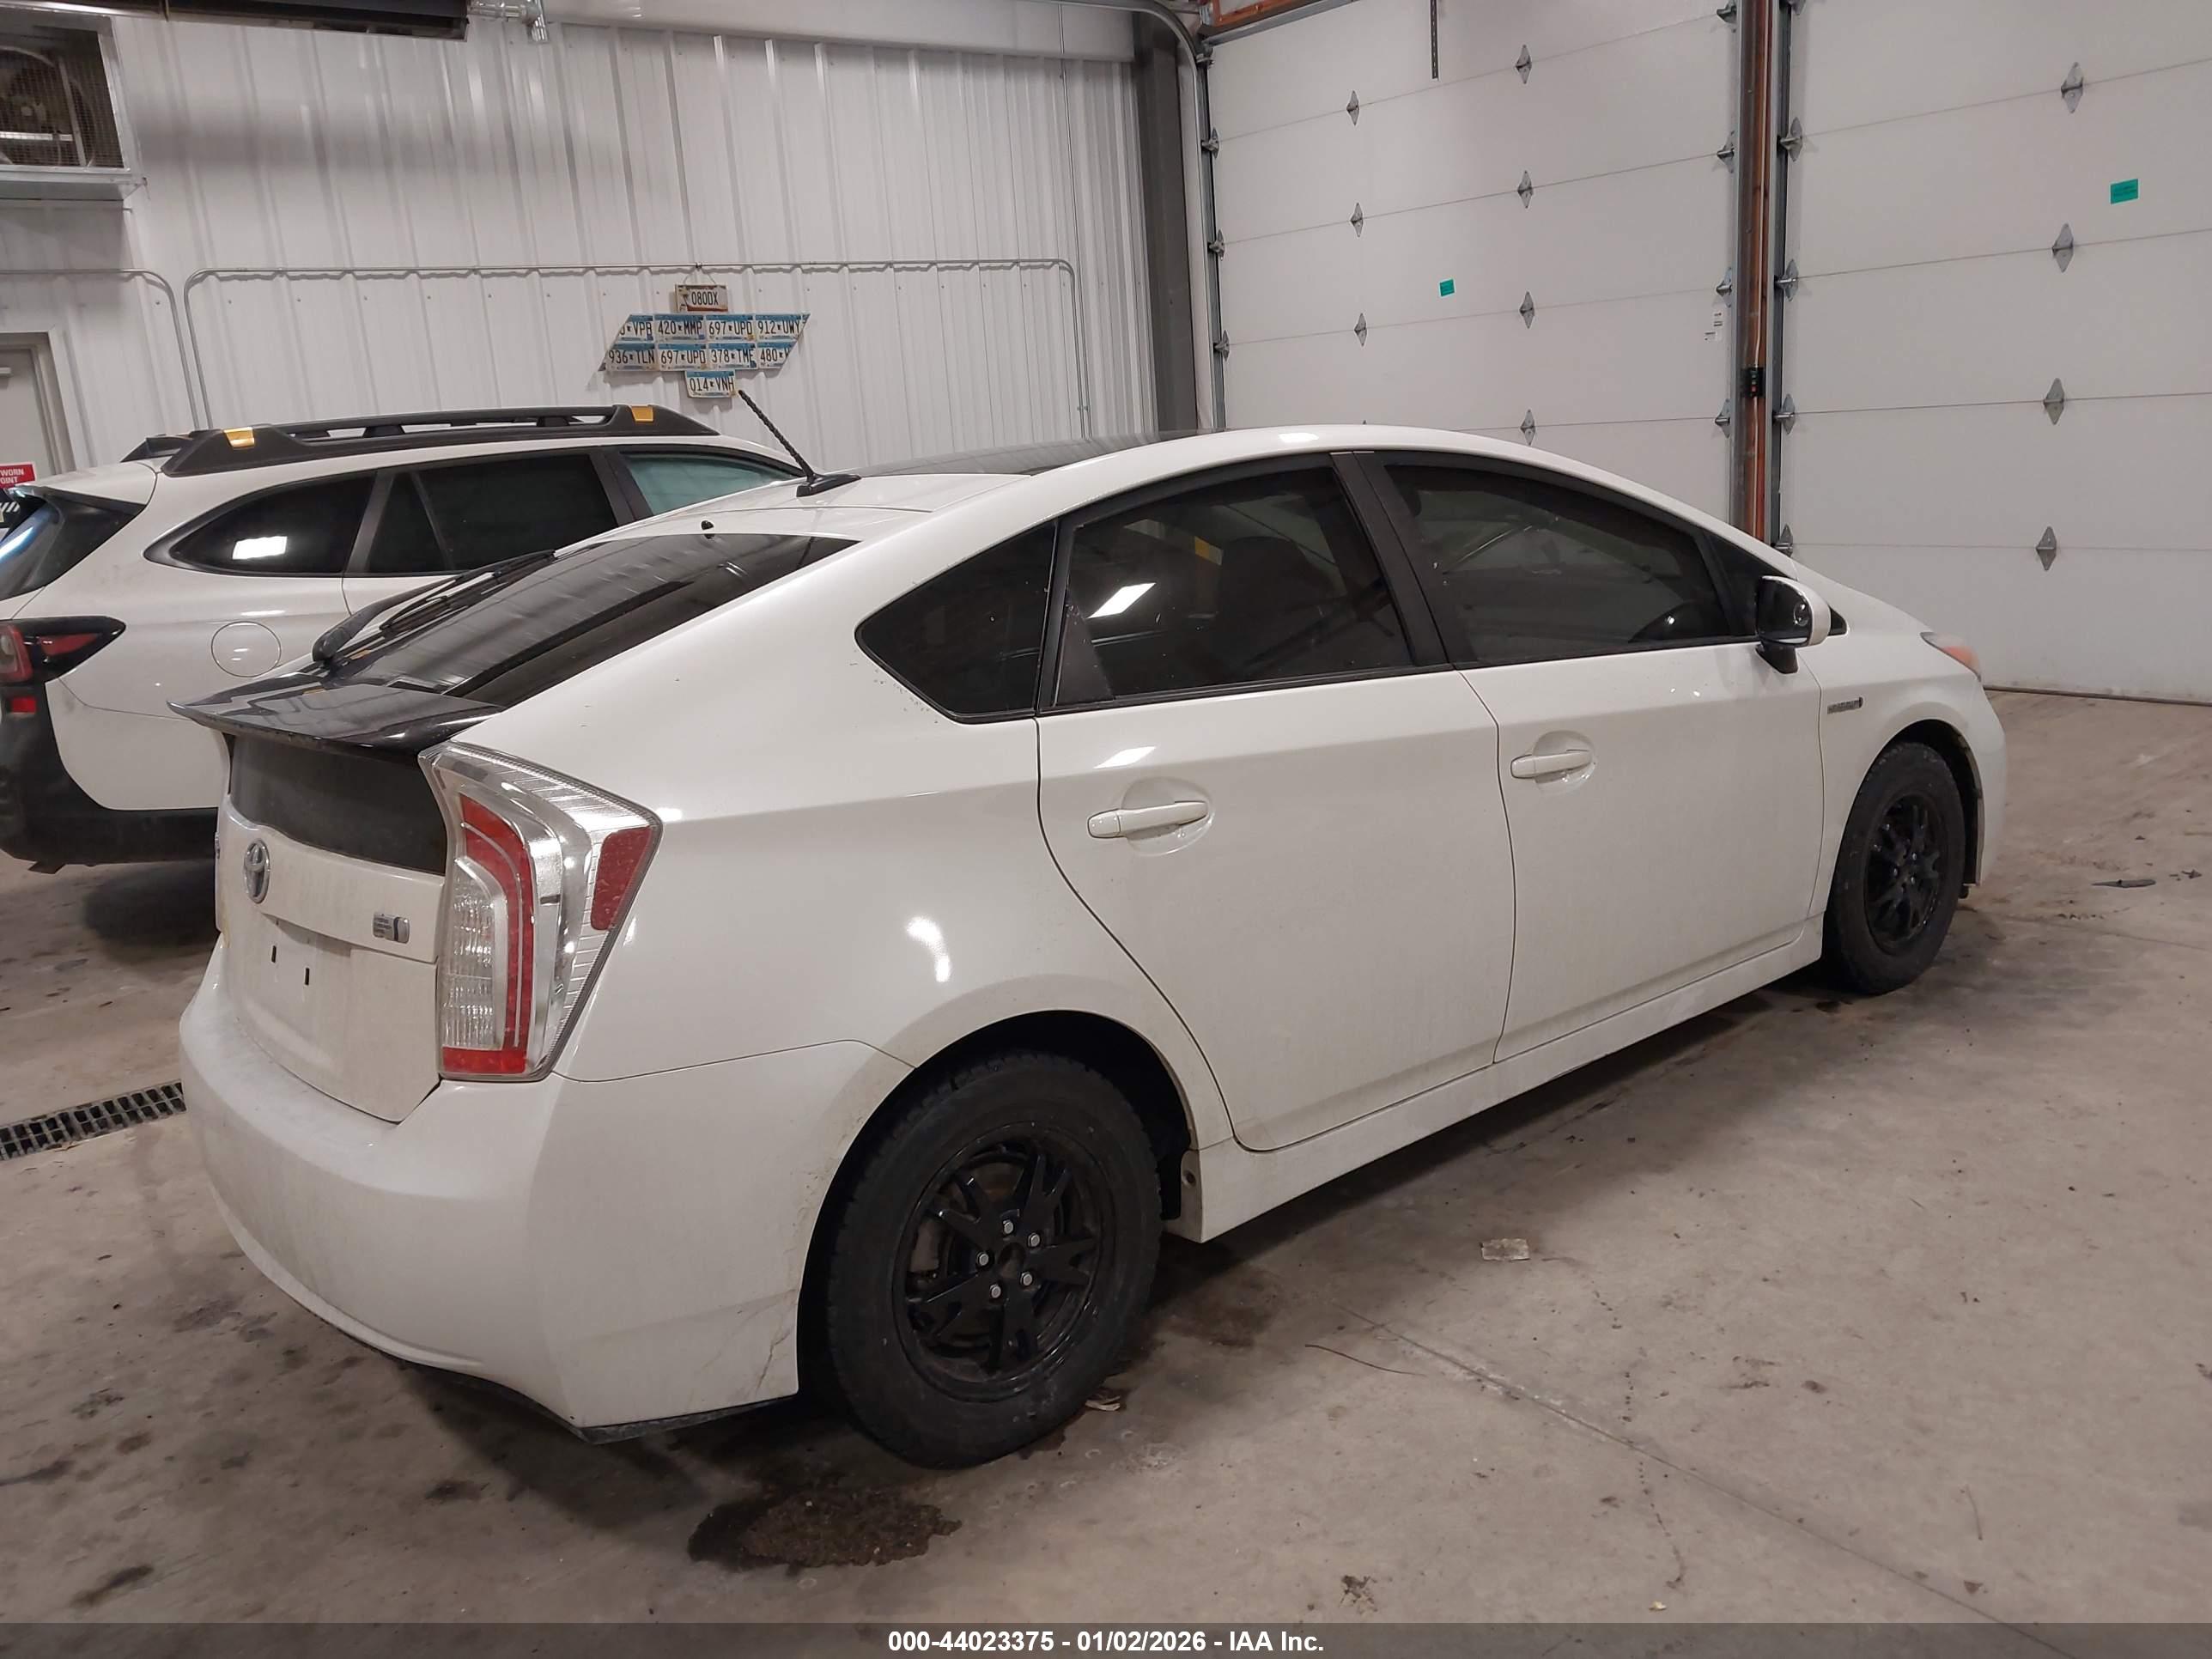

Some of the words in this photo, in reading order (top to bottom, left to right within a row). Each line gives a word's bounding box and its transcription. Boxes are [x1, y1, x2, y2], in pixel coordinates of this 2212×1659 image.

[658, 320, 677, 335] 420
[708, 321, 726, 335] 697
[757, 320, 776, 334] 912
[608, 349, 628, 364] 936
[660, 349, 678, 364] 697
[711, 349, 730, 363] 378
[760, 348, 778, 362] 480
[690, 378, 709, 392] 014
